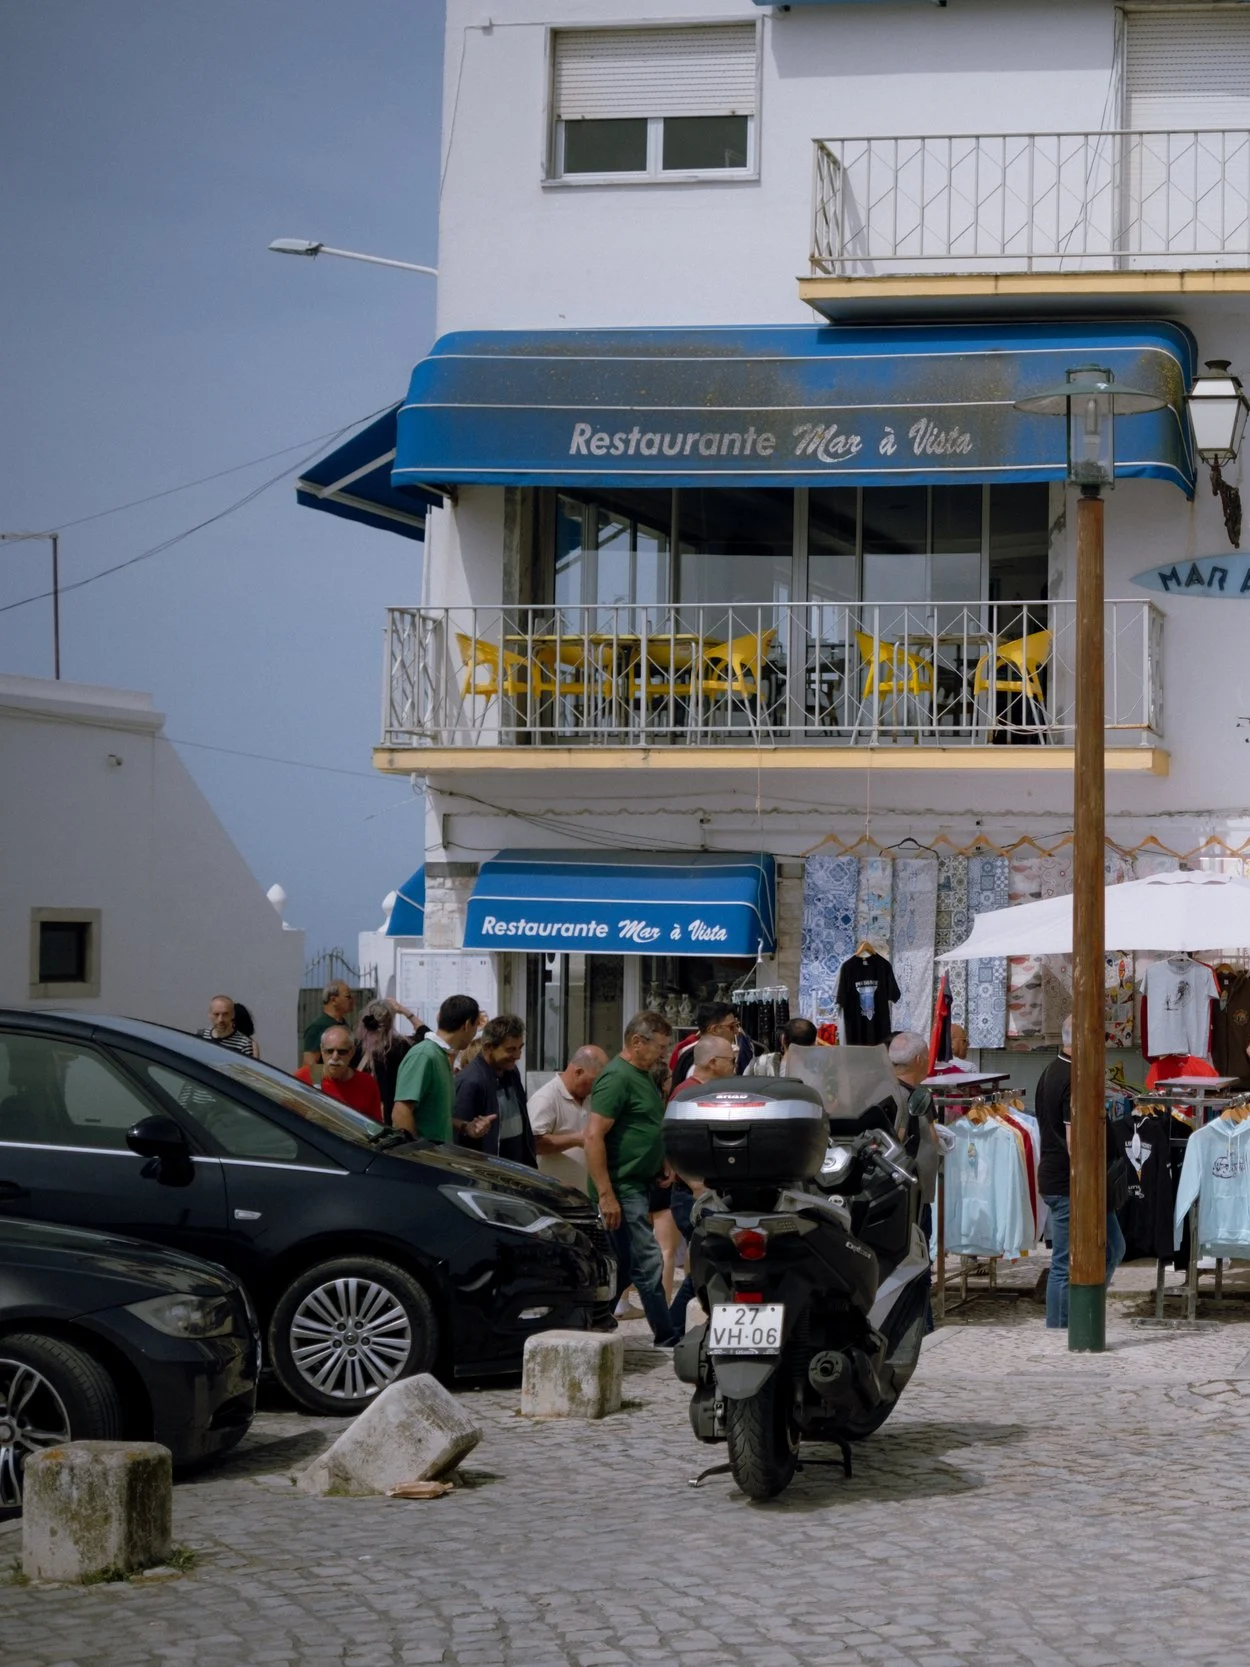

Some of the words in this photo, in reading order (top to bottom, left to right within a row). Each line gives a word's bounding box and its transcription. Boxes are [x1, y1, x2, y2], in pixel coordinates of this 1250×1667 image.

[568, 422, 777, 456] Restaurante
[792, 423, 863, 464] Mar
[879, 425, 898, 456] à
[908, 417, 973, 456] Vista
[1157, 562, 1229, 592] MAR
[481, 915, 609, 938] Restaurante
[618, 919, 661, 943] Mar
[669, 923, 682, 941] à
[688, 919, 728, 941] Vista
[734, 1307, 760, 1326] 27
